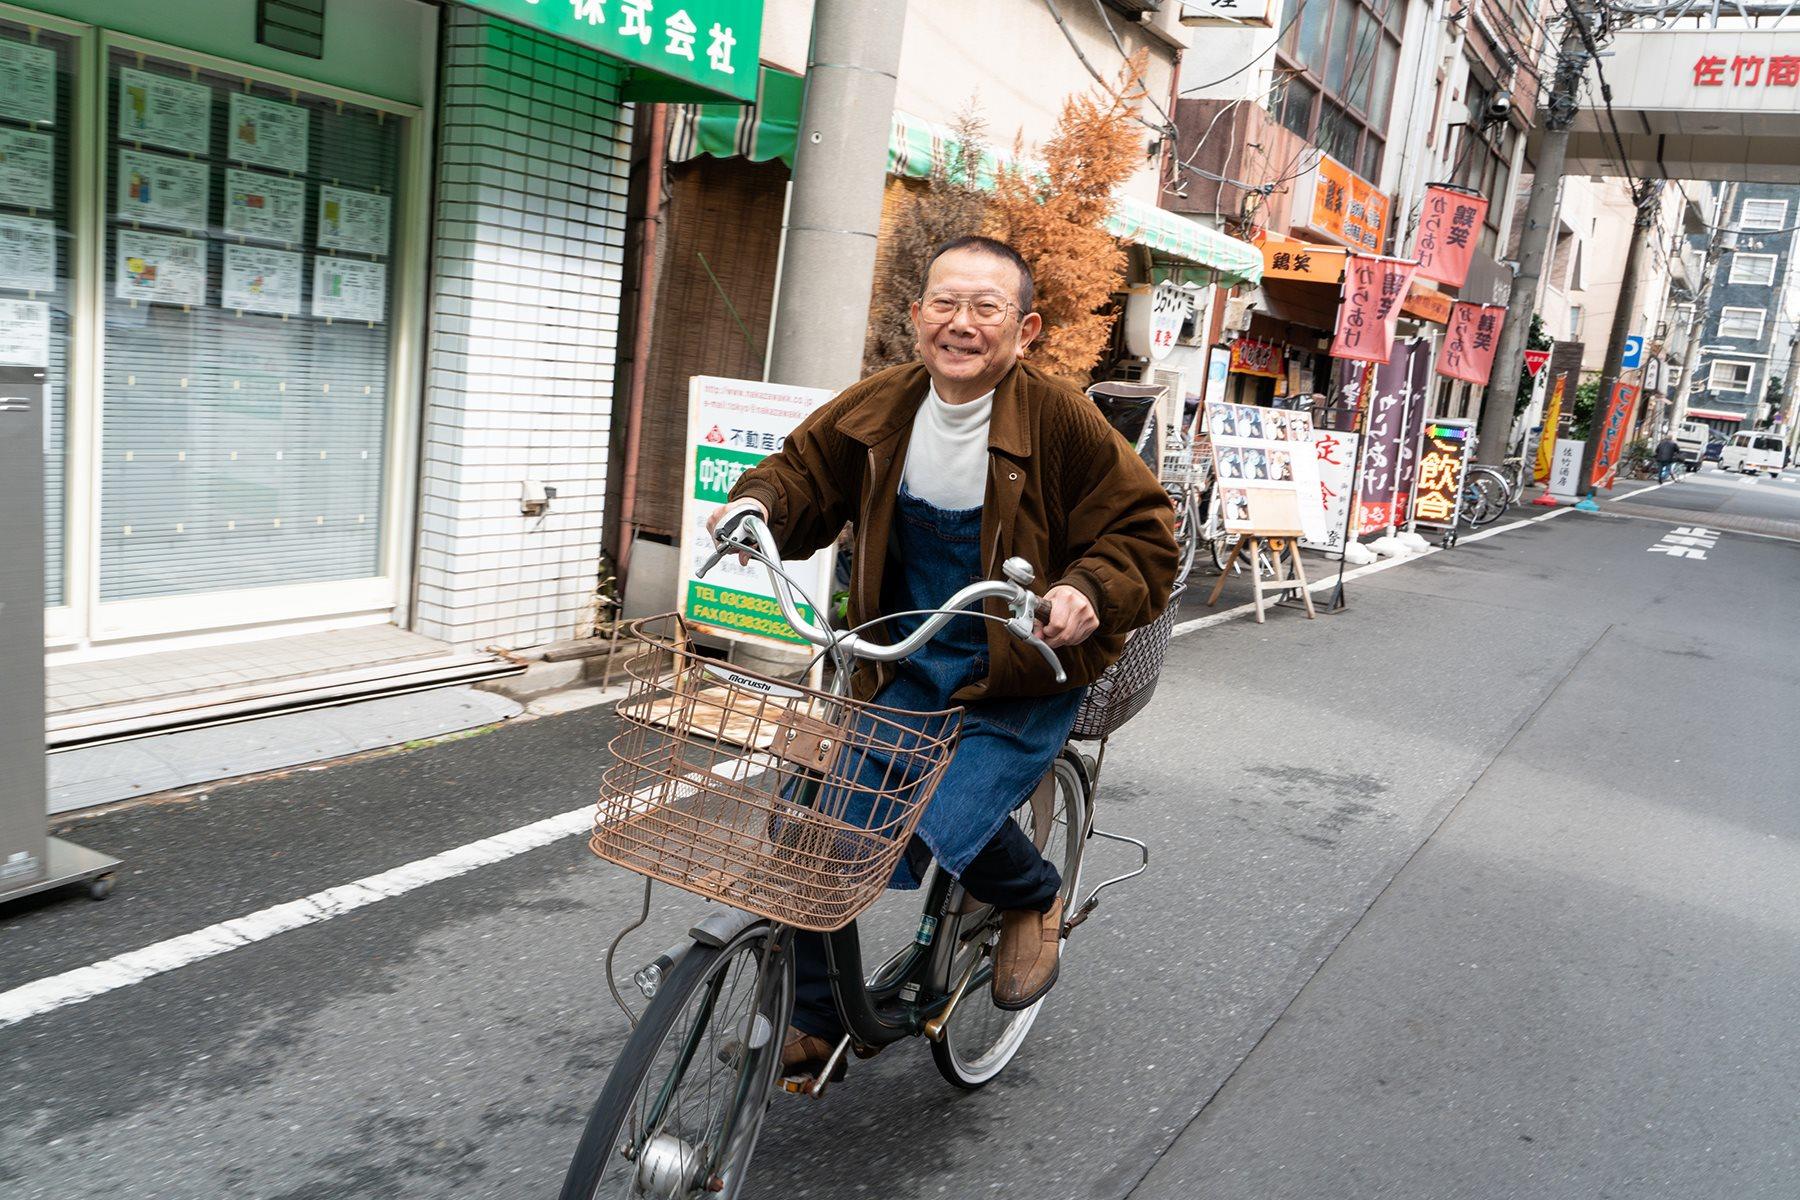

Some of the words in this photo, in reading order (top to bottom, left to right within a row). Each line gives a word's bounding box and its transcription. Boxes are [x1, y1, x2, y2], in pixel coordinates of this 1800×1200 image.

[1693, 55, 1800, 87] 佐竹商
[1272, 252, 1311, 272] 鶏笑
[695, 586, 718, 602] TEL
[694, 605, 719, 621] FAX
